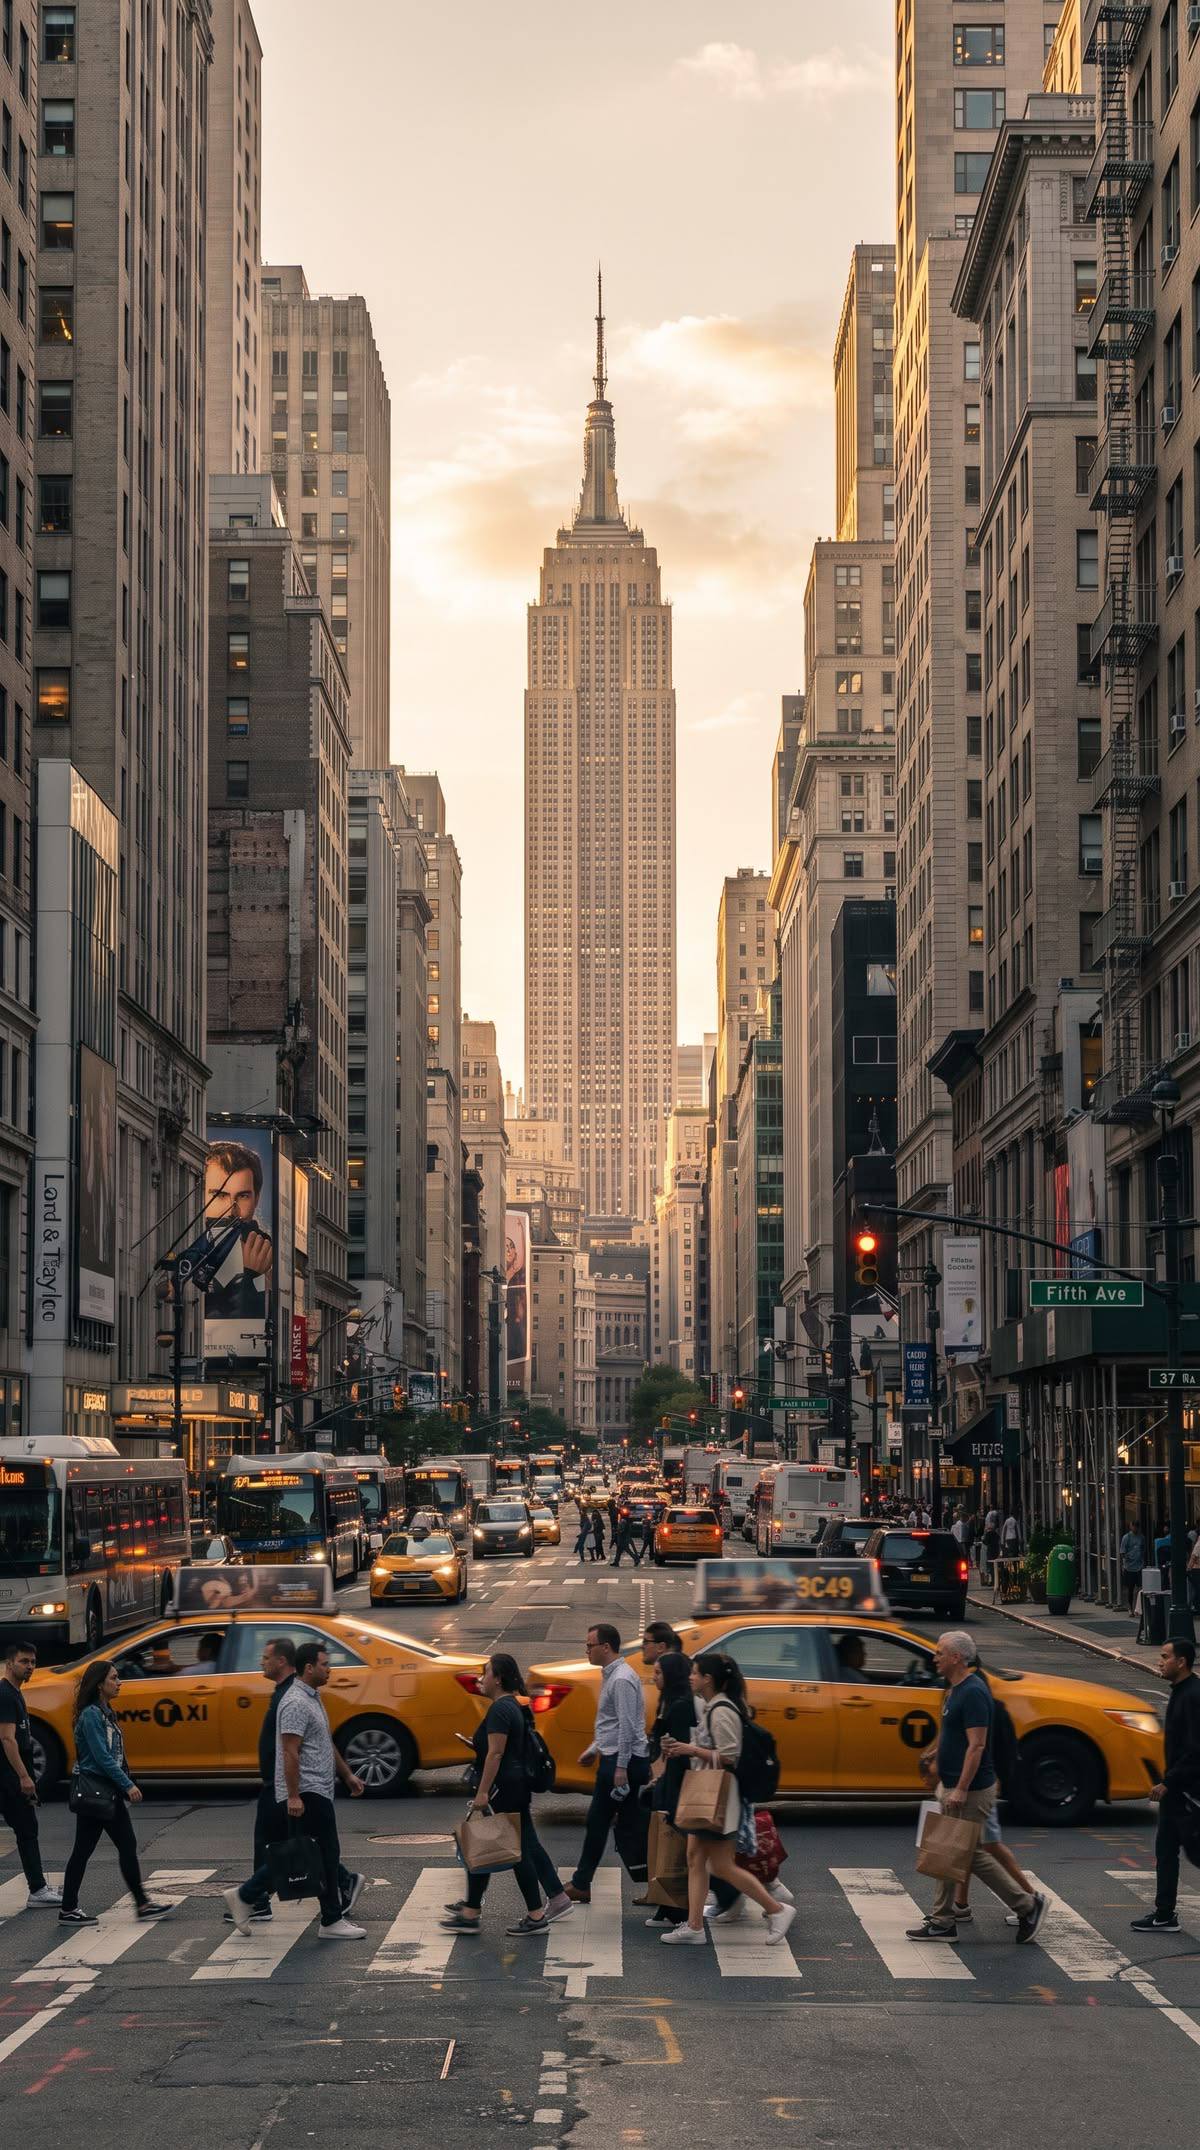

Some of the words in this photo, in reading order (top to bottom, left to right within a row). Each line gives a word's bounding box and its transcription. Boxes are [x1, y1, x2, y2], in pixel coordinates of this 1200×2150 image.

[43, 1174, 64, 1222] Lord
[43, 1228, 60, 1244] &
[1047, 1286, 1086, 1301] Fifth
[1095, 1286, 1127, 1301] Ave
[1159, 1373, 1176, 1385] 37
[795, 1576, 853, 1599] 3C49
